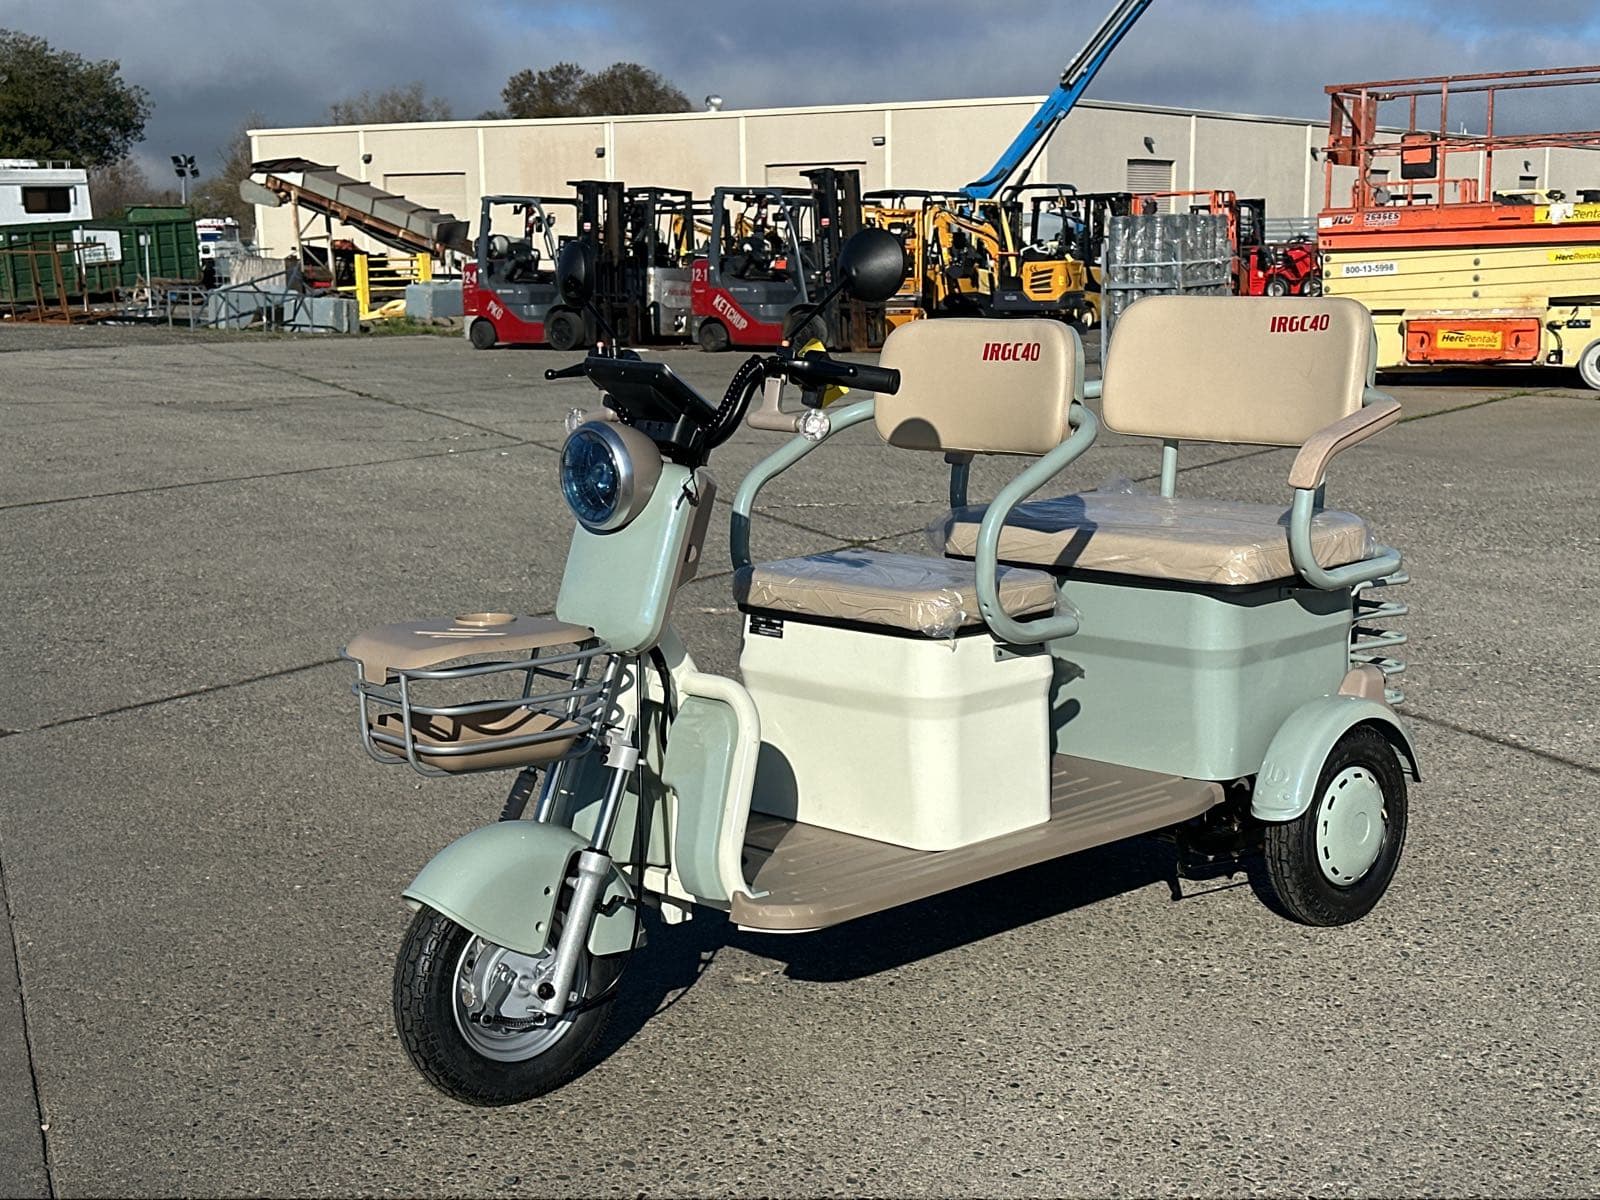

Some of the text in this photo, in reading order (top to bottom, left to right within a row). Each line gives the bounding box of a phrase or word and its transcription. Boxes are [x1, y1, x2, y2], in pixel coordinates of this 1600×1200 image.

[1345, 263, 1394, 274] 800-13-5998
[712, 294, 748, 331] KETCHUP
[1270, 314, 1330, 333] IRGC40
[1441, 333, 1498, 343] HercRentals
[982, 342, 1041, 361] IRGC40
